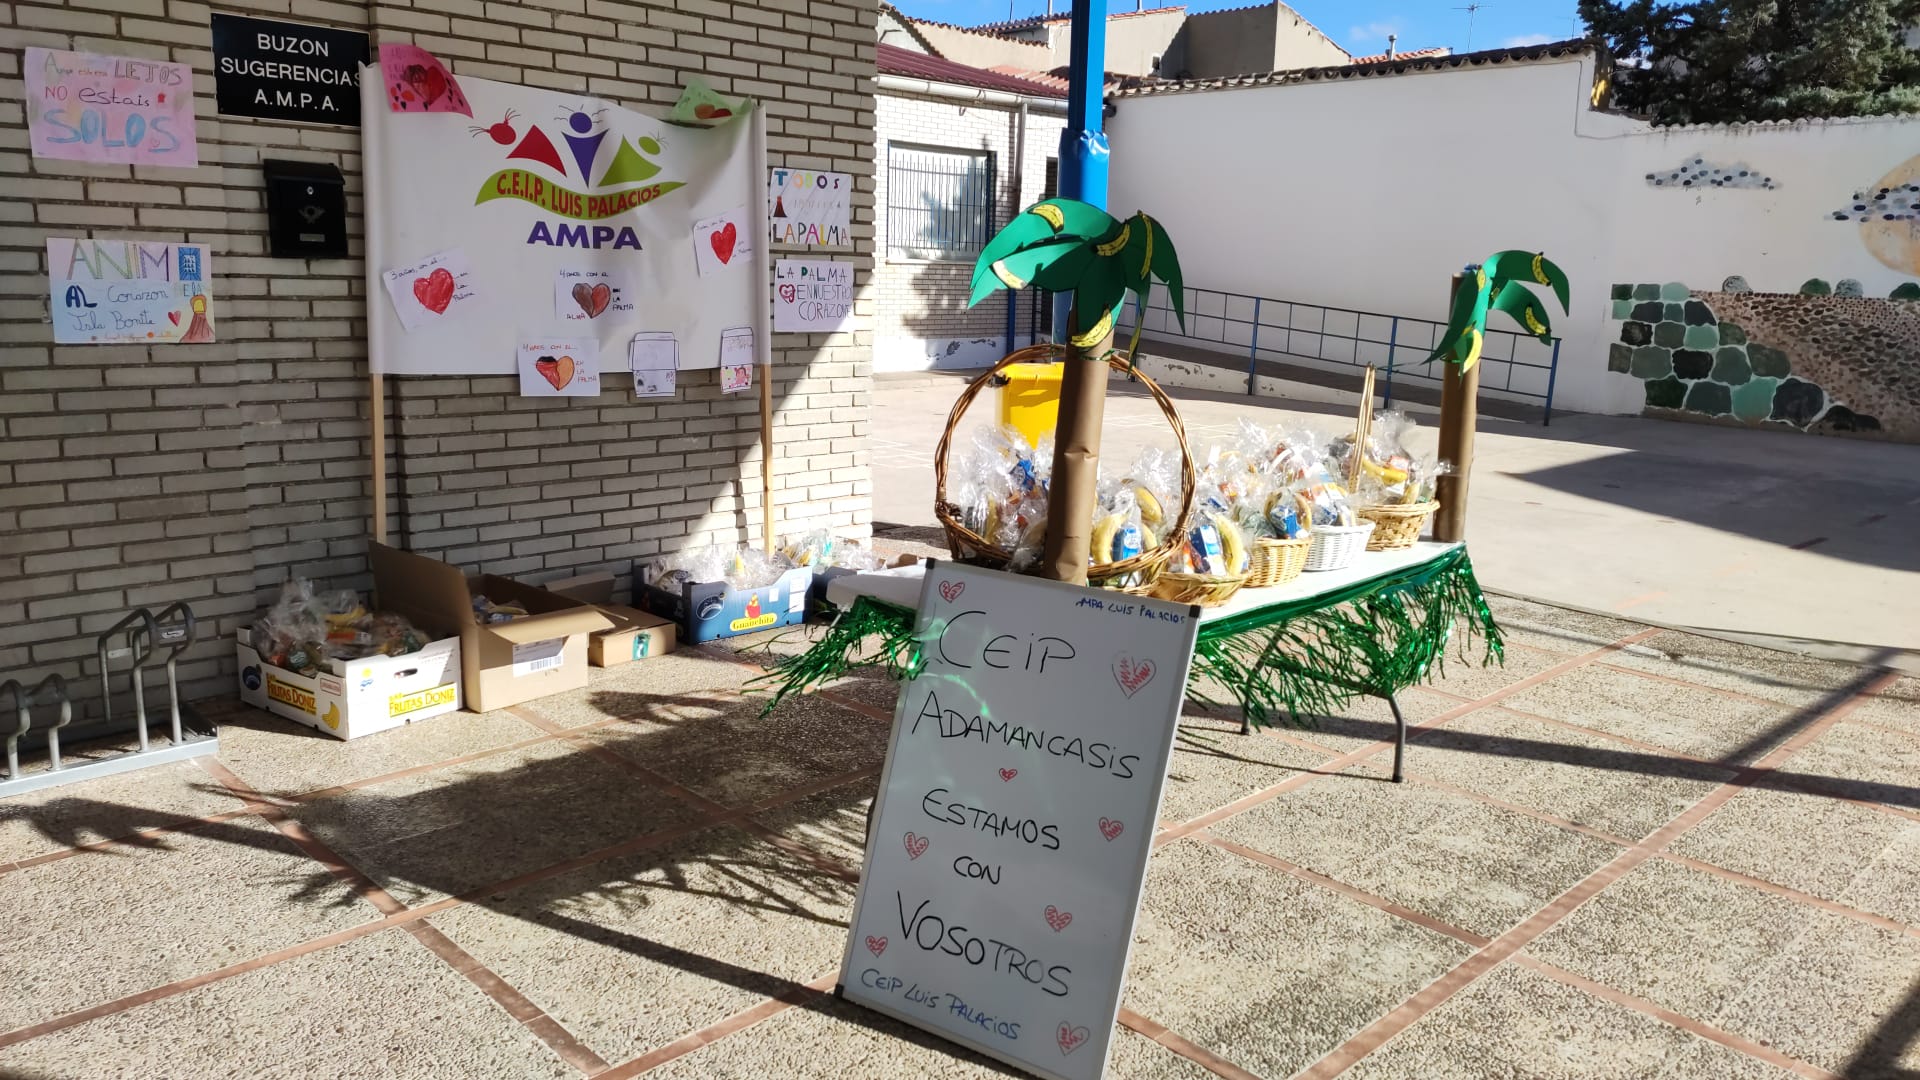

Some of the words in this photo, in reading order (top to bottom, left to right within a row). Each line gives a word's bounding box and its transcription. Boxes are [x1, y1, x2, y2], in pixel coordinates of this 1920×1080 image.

[258, 33, 328, 57] BUZON
[114, 59, 182, 86] LEJOS
[45, 85, 68, 101] NO
[44, 108, 181, 153] SOLOS
[774, 171, 839, 189] TODOS
[497, 172, 546, 205] C.E.I.P.
[551, 185, 582, 217] LUIS
[588, 184, 661, 217] PALACIOS
[526, 221, 643, 250] AMPA
[777, 266, 794, 279] LA
[801, 266, 848, 283] PALMA
[66, 285, 98, 308] AL
[1108, 603, 1135, 615] LUIS
[1140, 605, 1185, 624] PALACIOS
[267, 680, 292, 700] FRUTAS
[389, 697, 423, 715] FRUTAS
[425, 688, 455, 704] DONIZ
[922, 789, 1060, 849] ESTAMOS
[953, 856, 1001, 884] CON
[897, 890, 1071, 996] VOSOTROS
